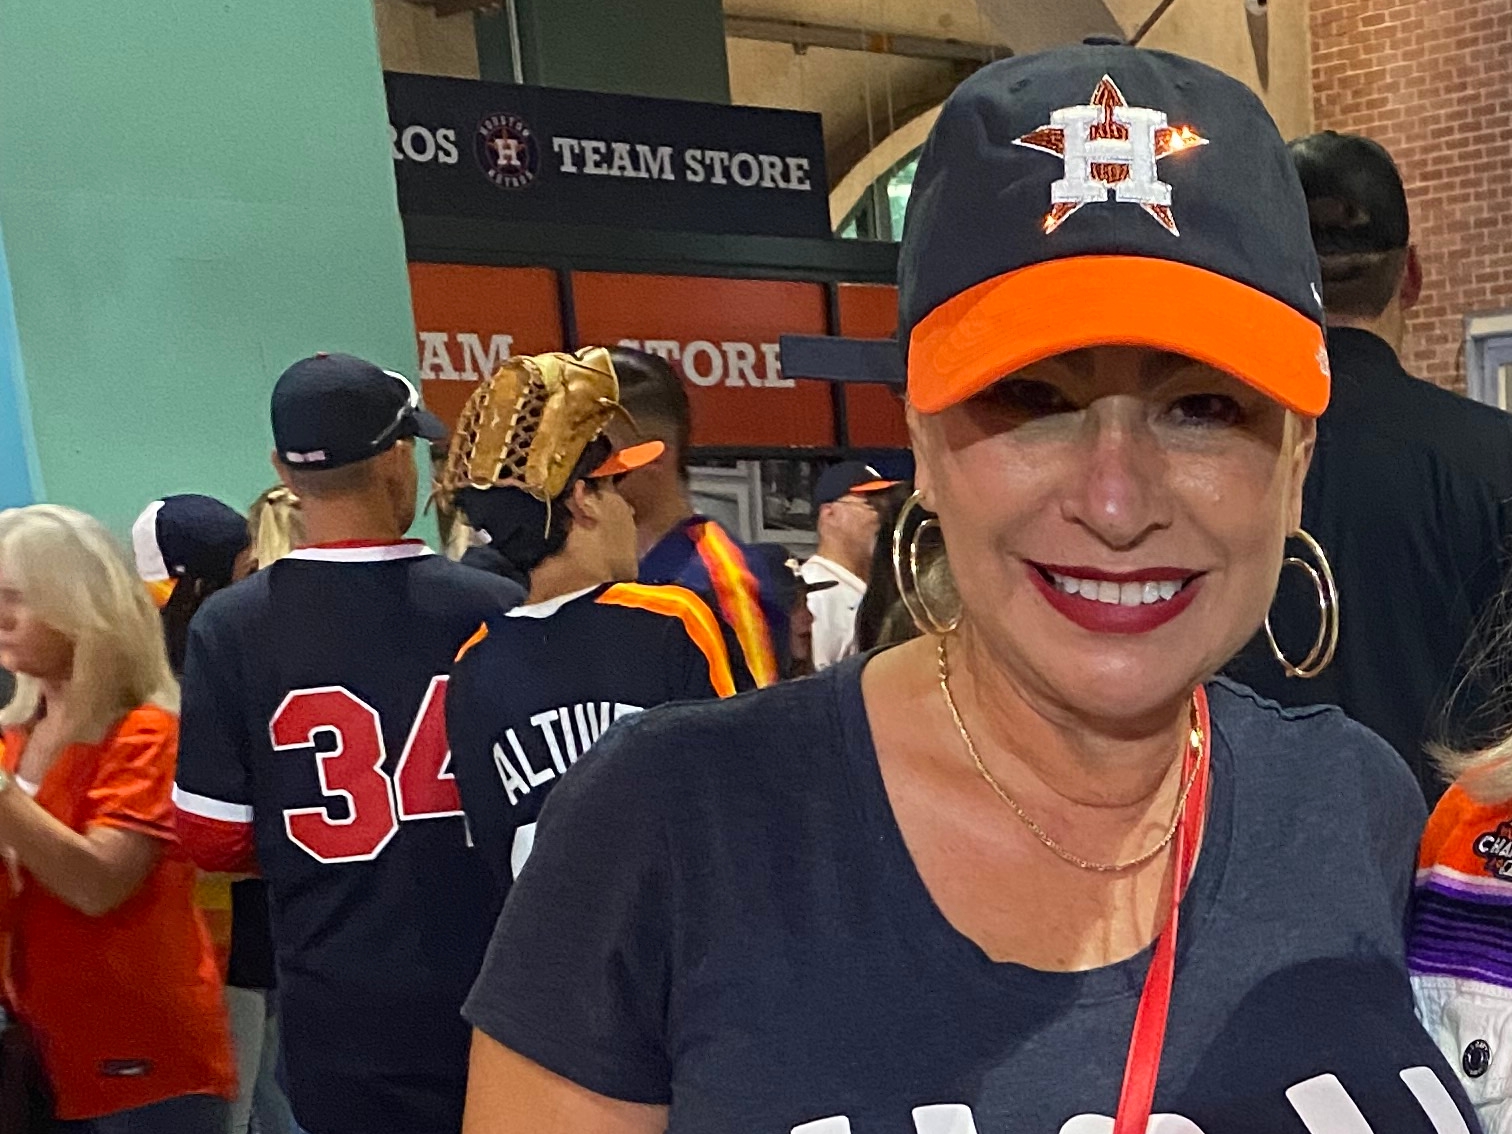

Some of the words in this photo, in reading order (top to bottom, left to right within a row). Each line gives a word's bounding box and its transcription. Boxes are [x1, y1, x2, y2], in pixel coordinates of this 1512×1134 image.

[495, 138, 521, 166] H
[552, 136, 675, 180] TEAM
[685, 149, 811, 190] STORE
[1050, 105, 1172, 205] H
